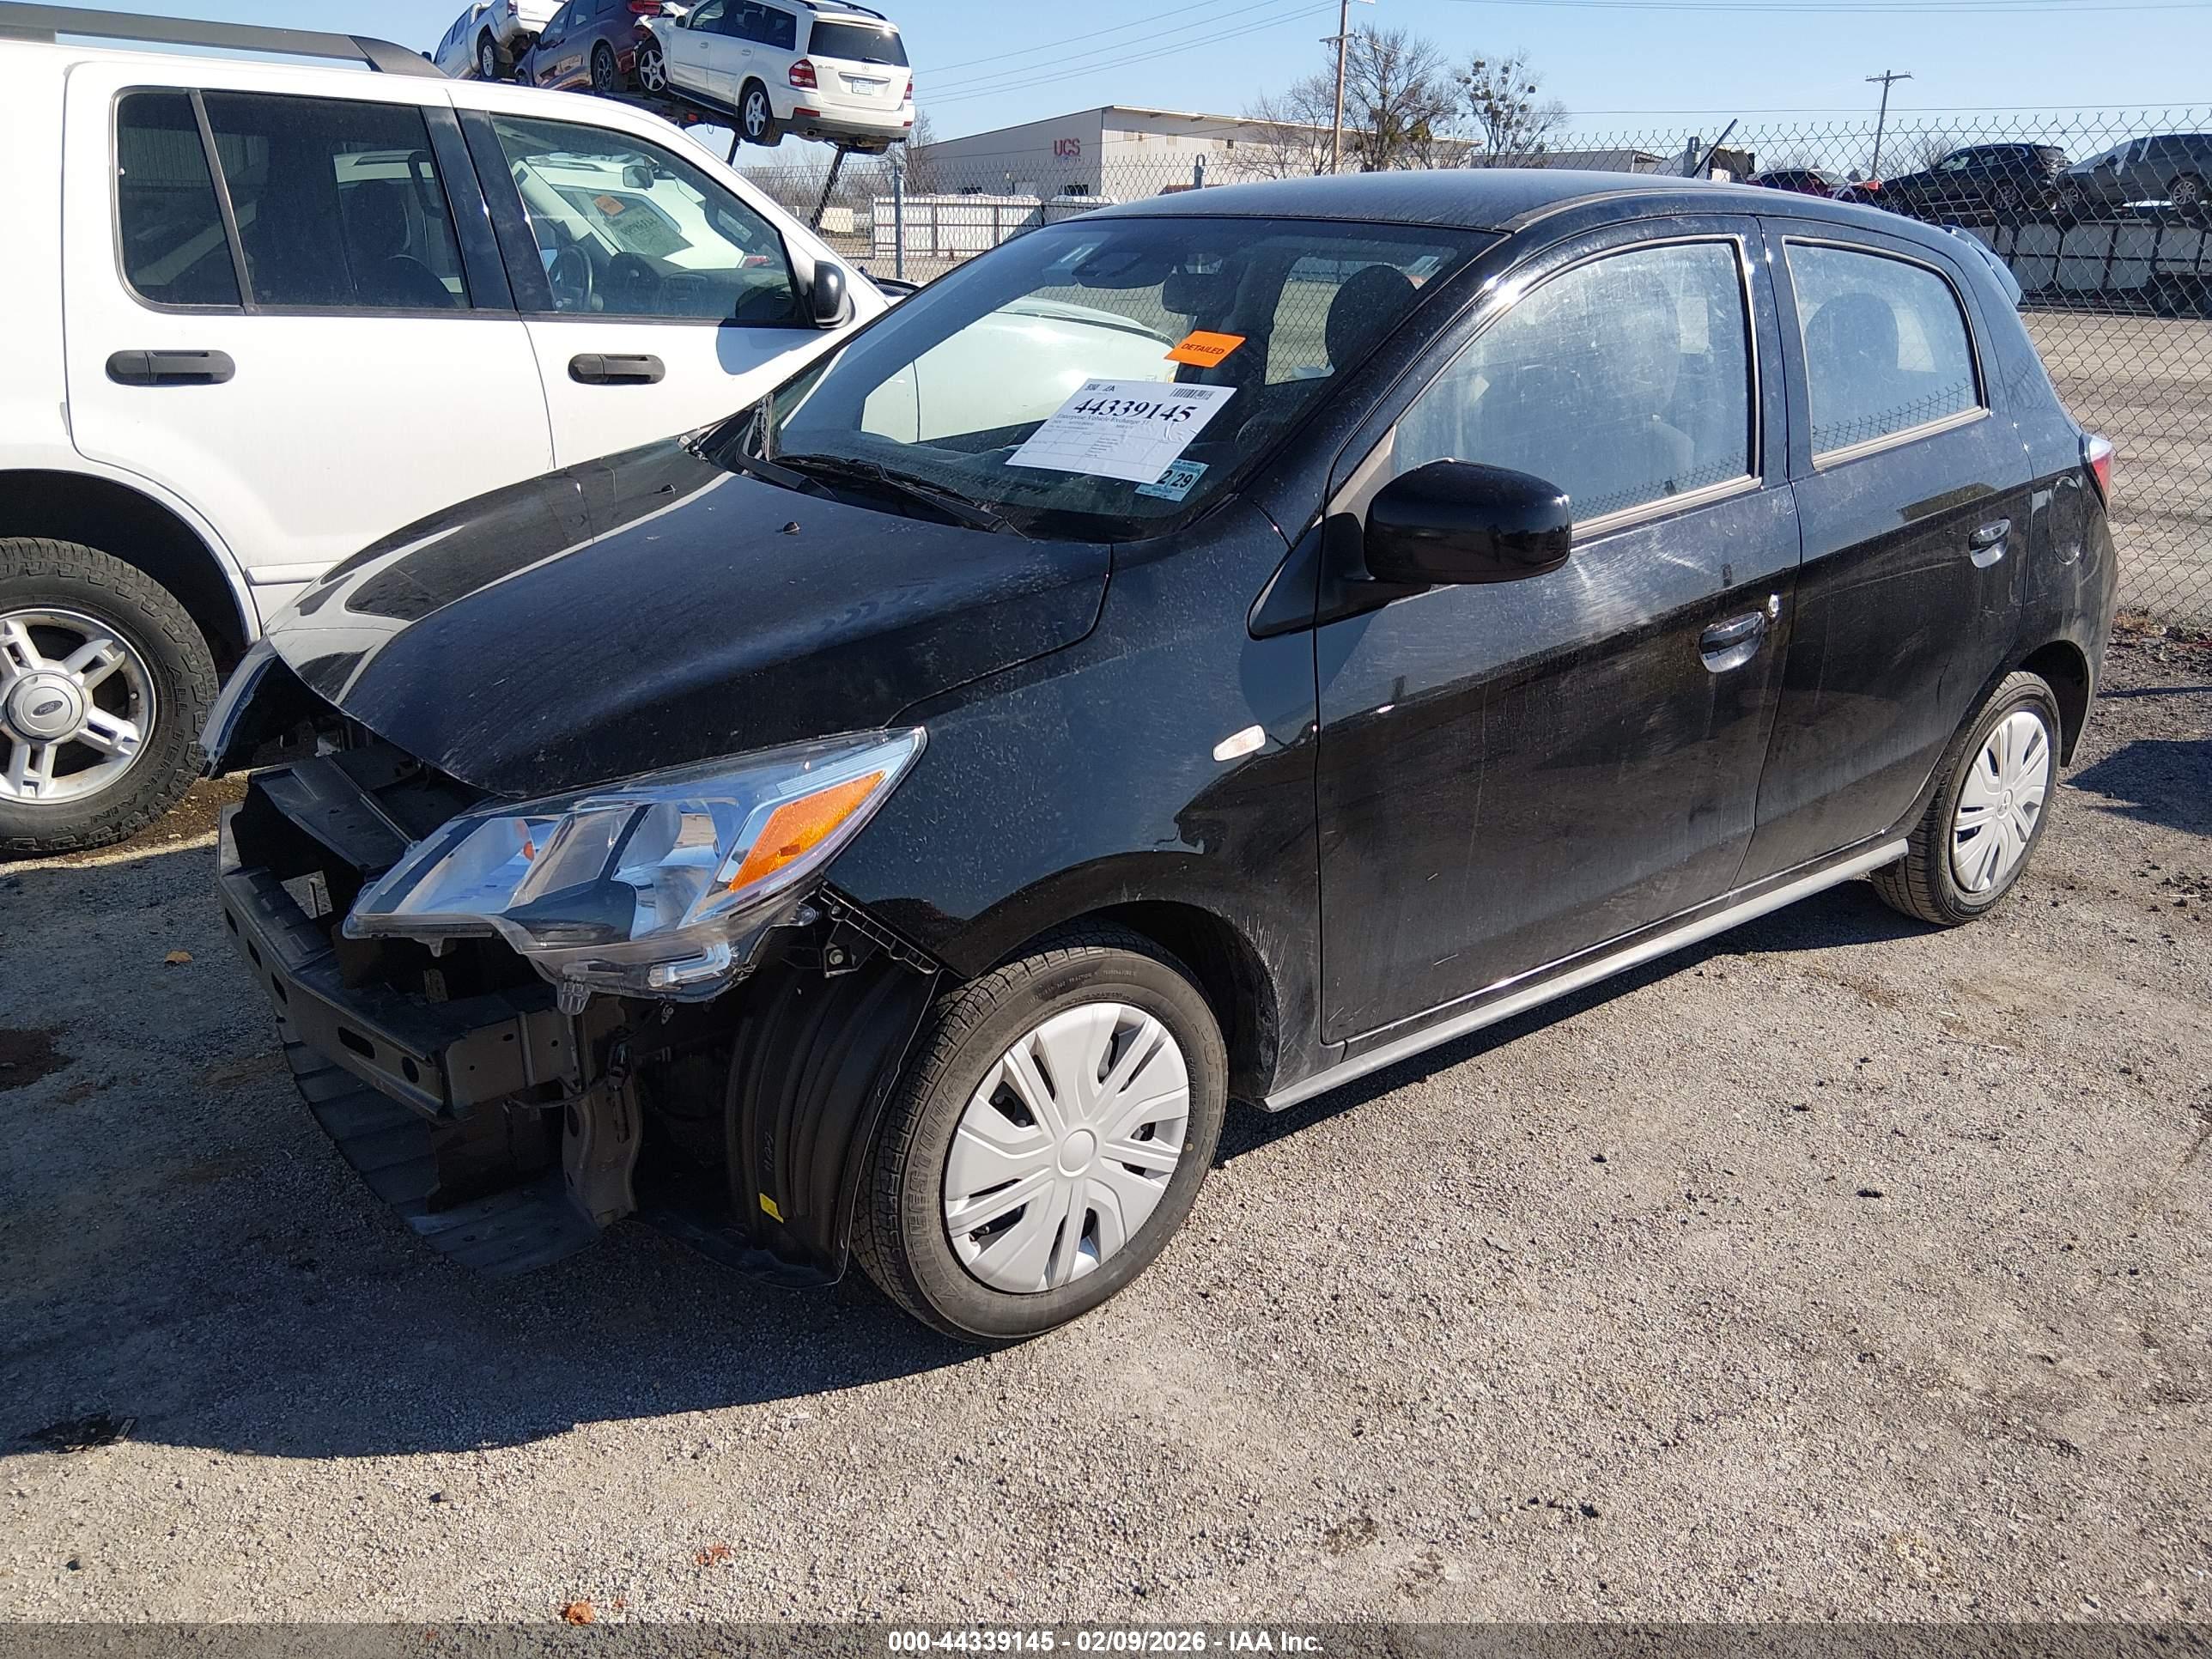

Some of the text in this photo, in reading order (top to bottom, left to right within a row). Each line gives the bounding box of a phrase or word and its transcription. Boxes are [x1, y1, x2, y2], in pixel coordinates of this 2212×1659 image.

[1054, 138, 1080, 155] UCS
[1182, 343, 1225, 355] DETAILED
[1074, 398, 1197, 422] 44339145
[1170, 473, 1193, 488] 29
